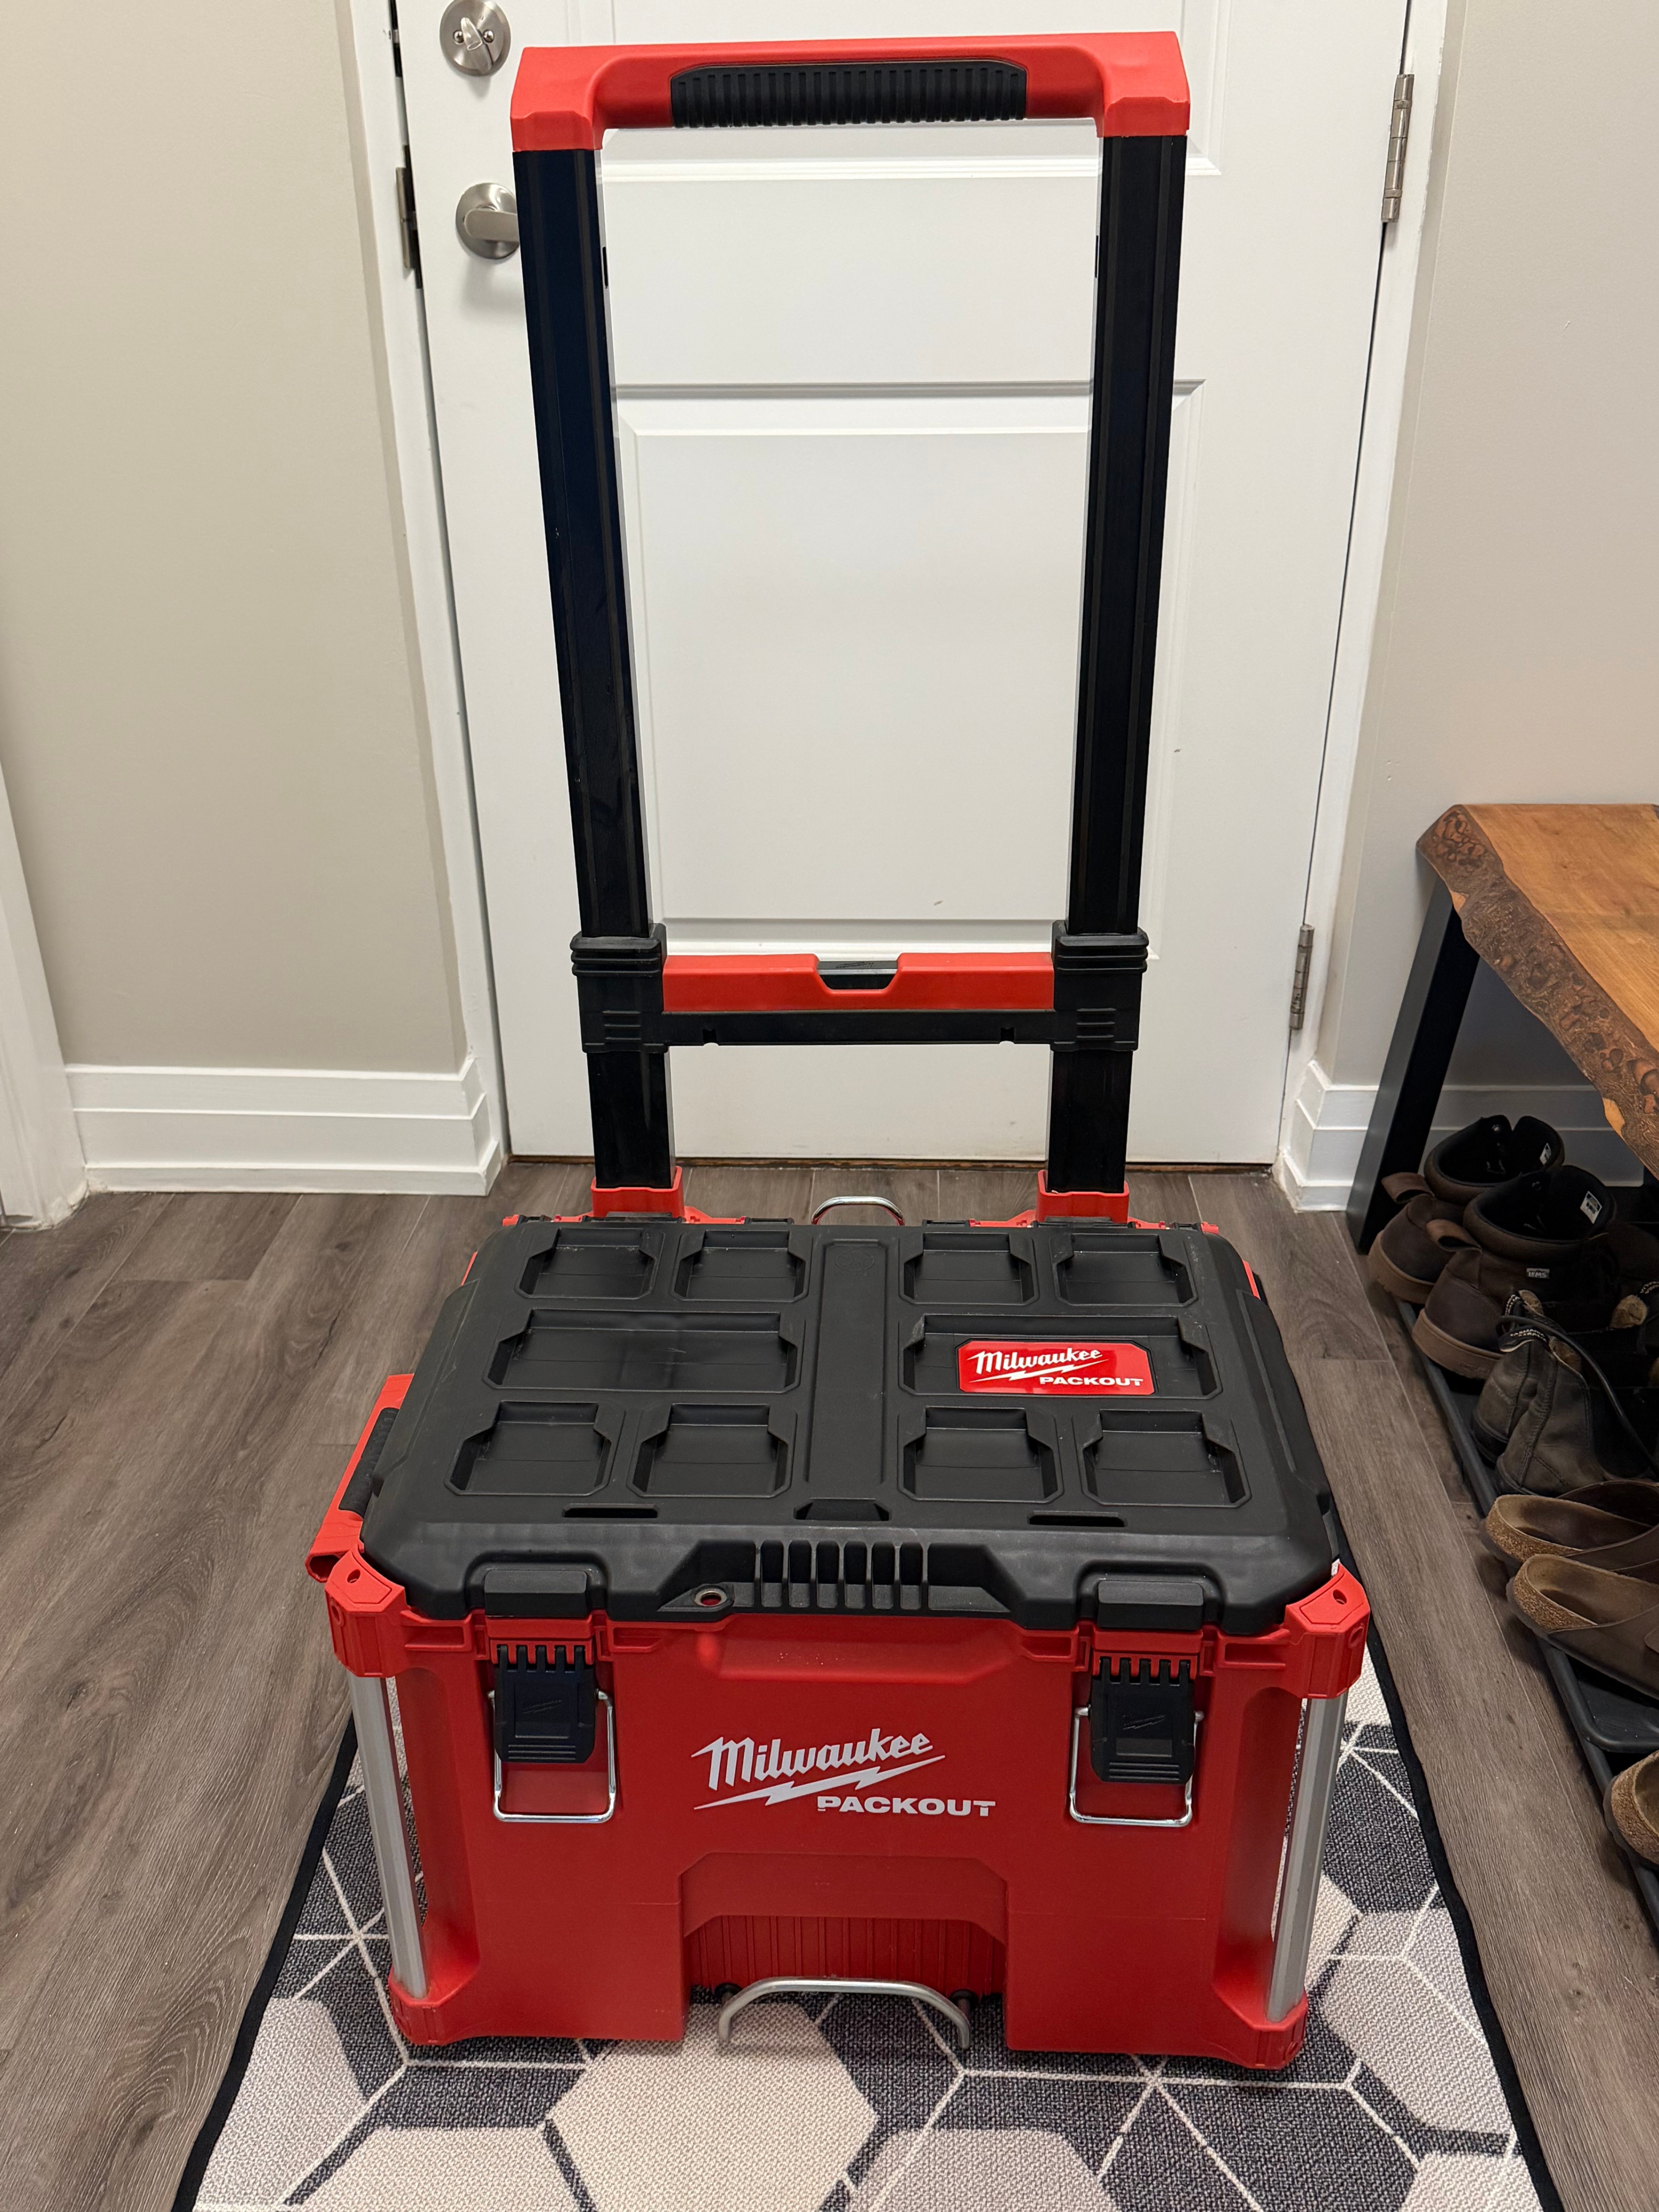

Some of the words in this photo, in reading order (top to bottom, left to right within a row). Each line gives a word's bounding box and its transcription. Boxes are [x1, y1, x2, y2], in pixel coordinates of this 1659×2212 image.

[967, 1348, 1103, 1374] Milwaukee
[1039, 1377, 1144, 1386] PACKOUT
[691, 1728, 933, 1791] Milwaukee
[817, 1796, 996, 1817] PACKOUT
